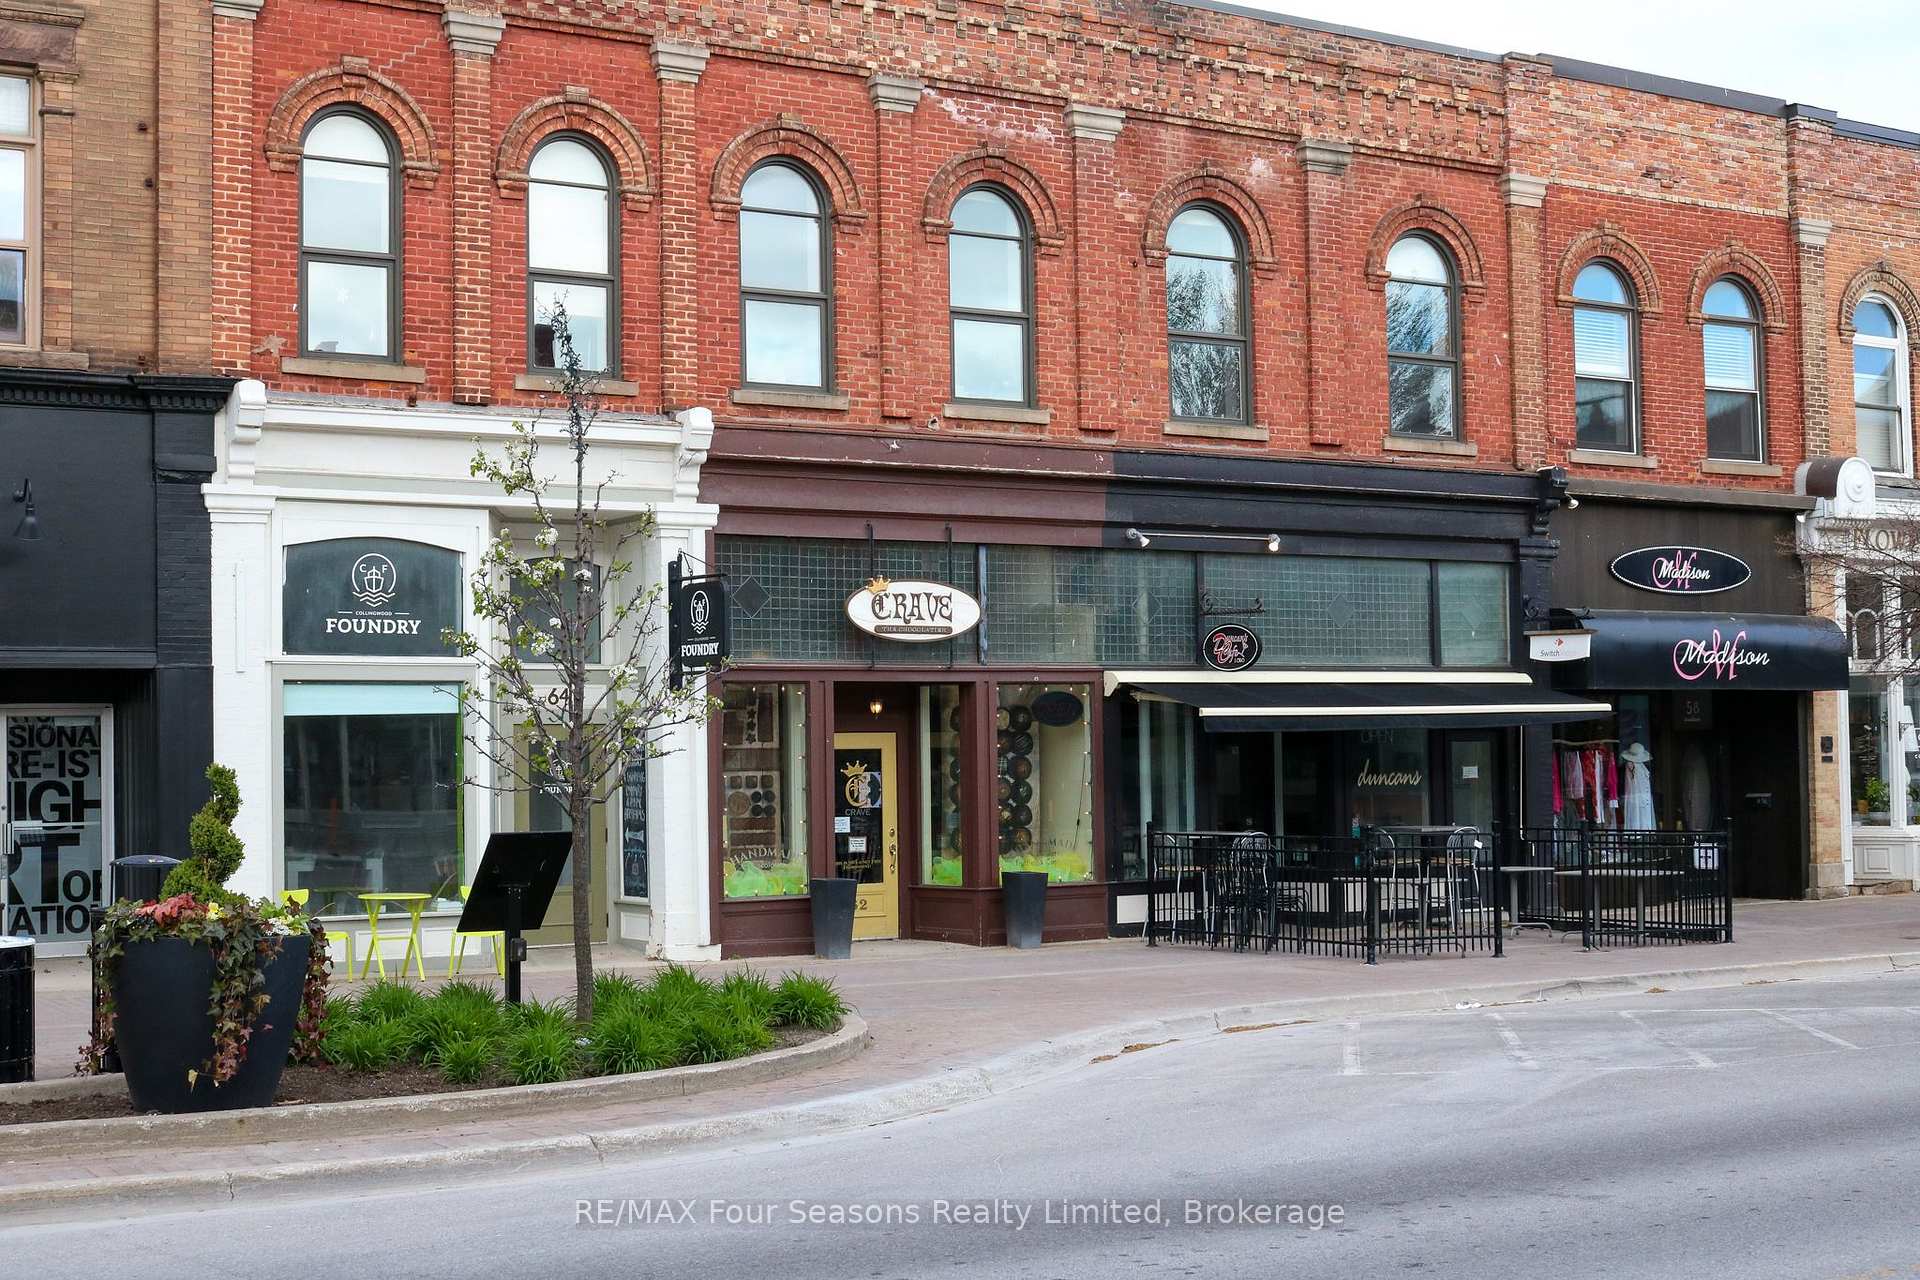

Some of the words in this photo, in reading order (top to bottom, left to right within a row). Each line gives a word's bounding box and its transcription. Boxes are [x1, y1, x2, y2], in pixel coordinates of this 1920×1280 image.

[359, 563, 367, 573] C
[382, 564, 388, 574] F
[1658, 559, 1711, 580] Madison
[871, 591, 953, 625] CRAVE
[326, 618, 421, 635] FOUNDRY
[681, 642, 719, 657] FOUNDRY
[1679, 640, 1770, 666] Madison
[548, 687, 569, 706] 64
[8, 724, 101, 748] SIONA
[1358, 759, 1422, 787] duncans
[845, 808, 871, 816] CRAVE
